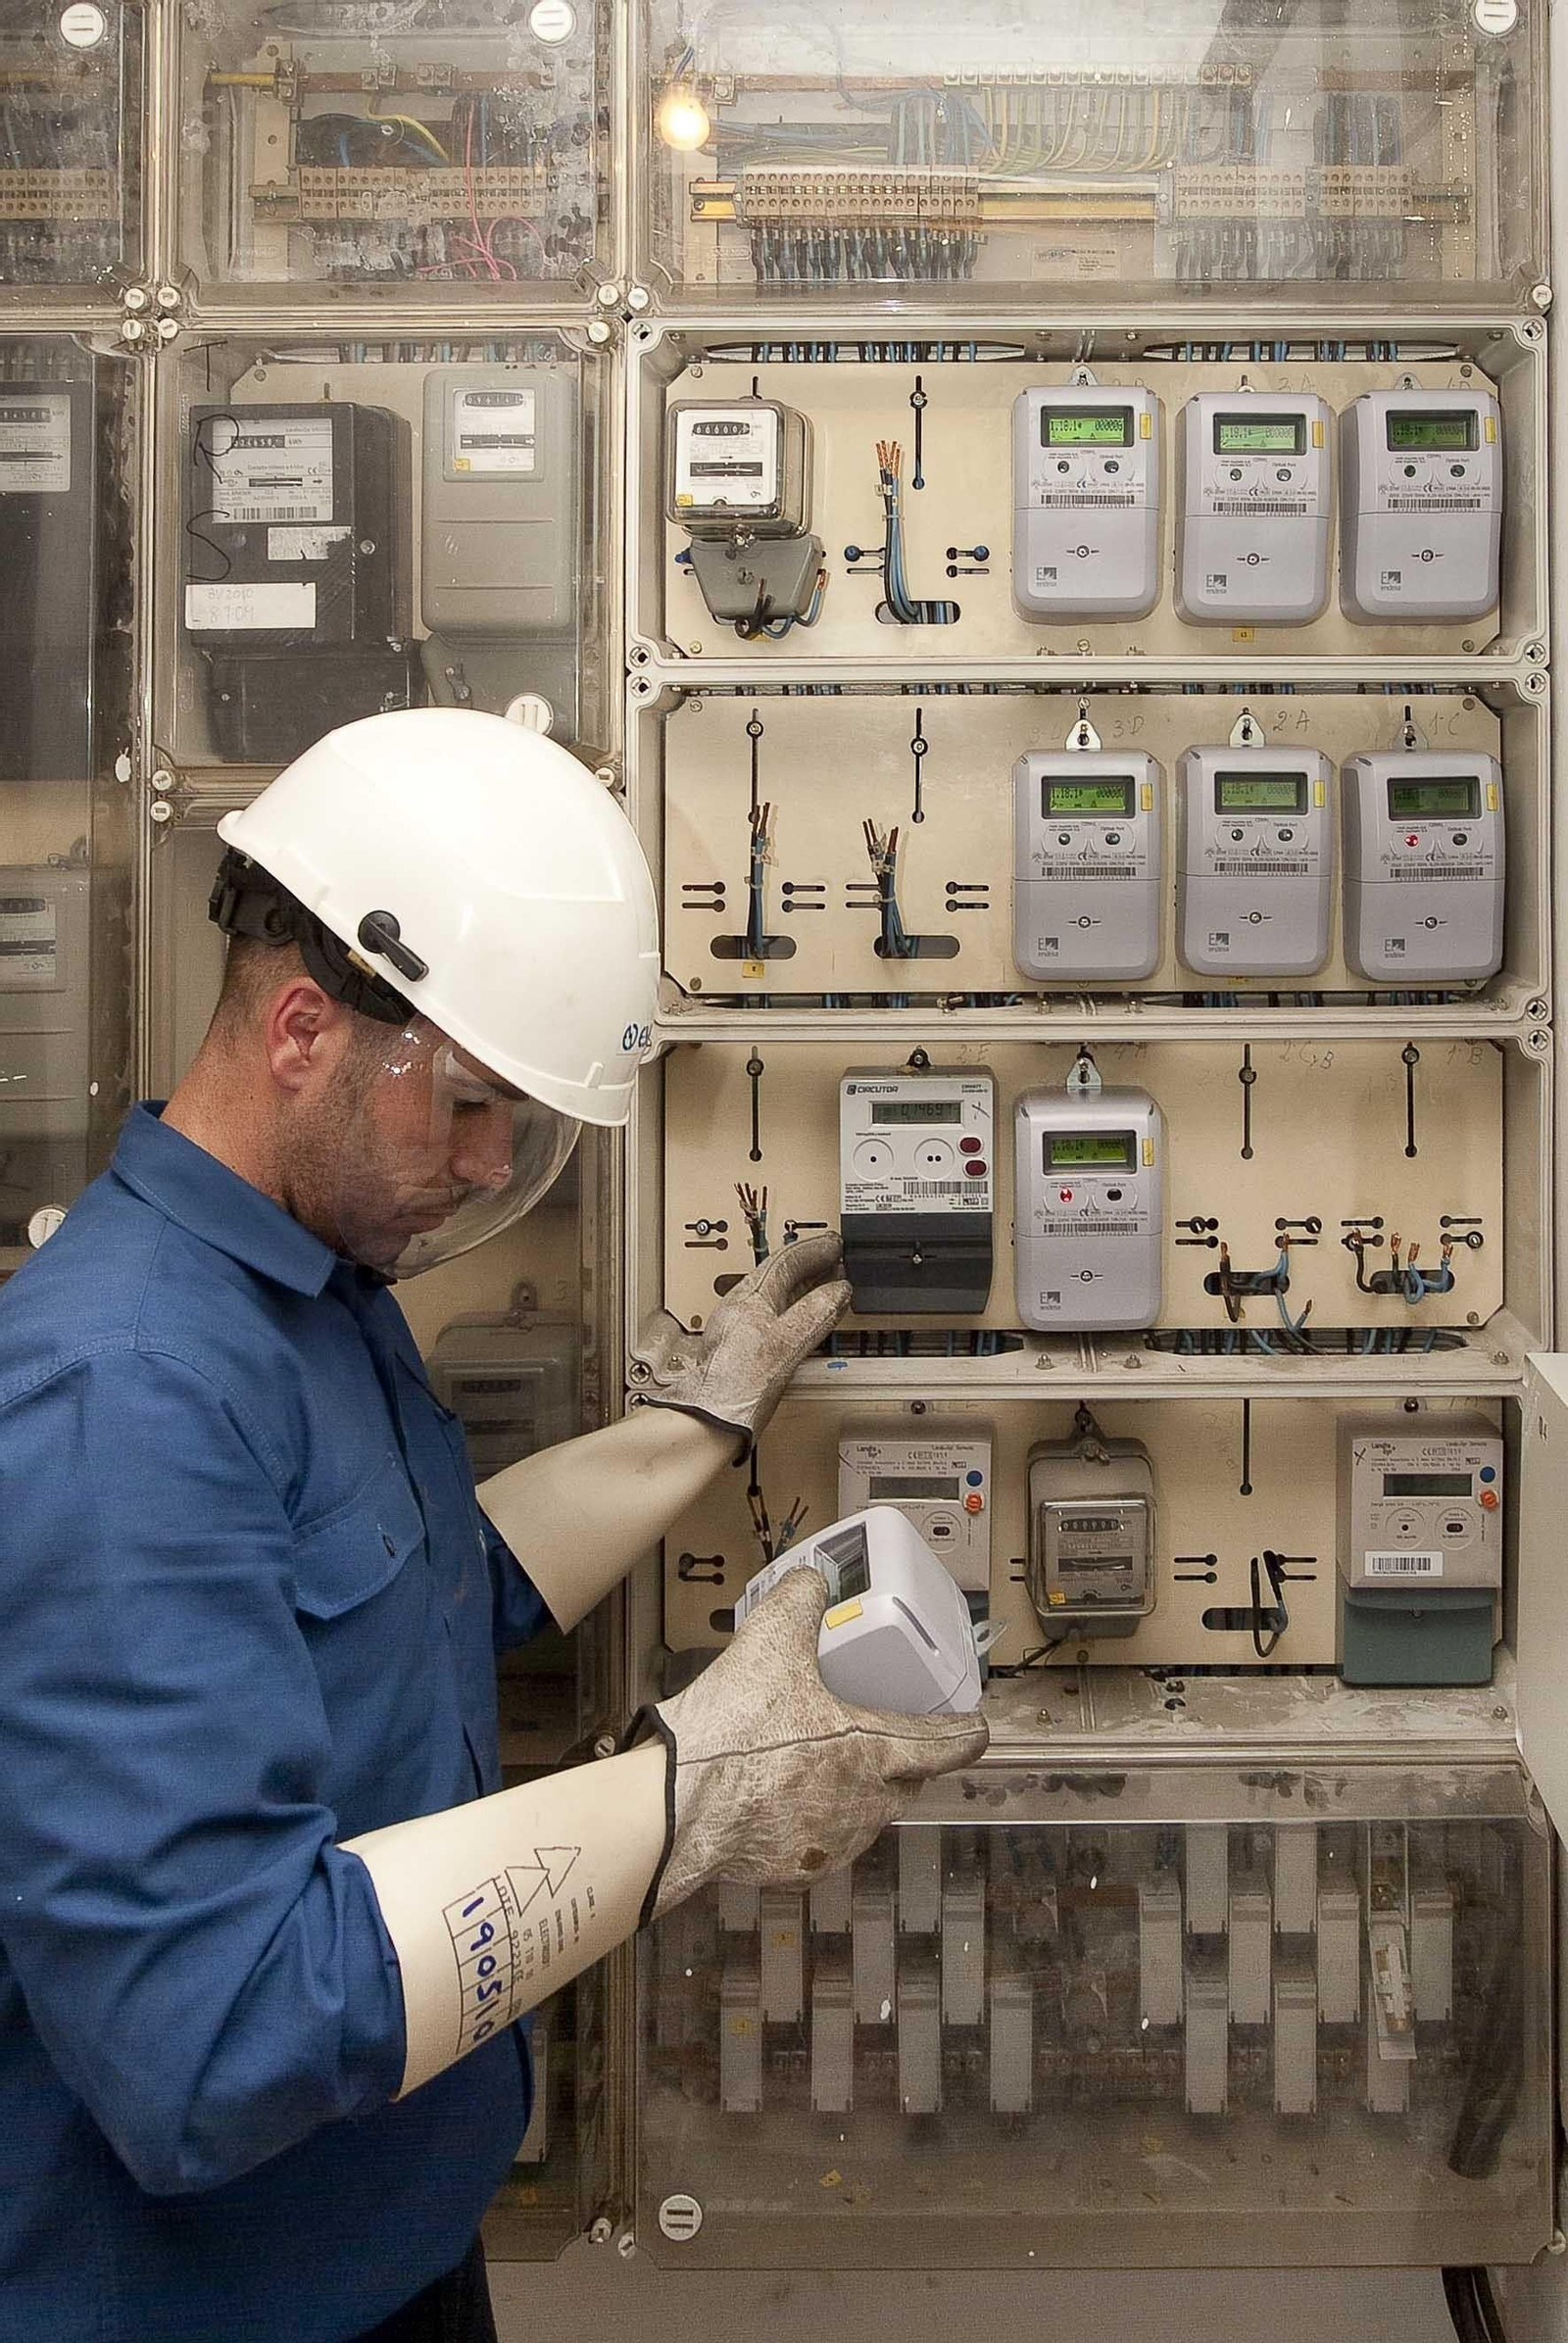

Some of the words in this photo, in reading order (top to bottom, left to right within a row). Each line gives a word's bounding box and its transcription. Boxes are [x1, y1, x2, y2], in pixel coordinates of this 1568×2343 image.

[183, 340, 228, 392] T
[193, 413, 240, 484] R
[185, 510, 231, 581] S
[857, 1085, 899, 1094] CIRCUTOR
